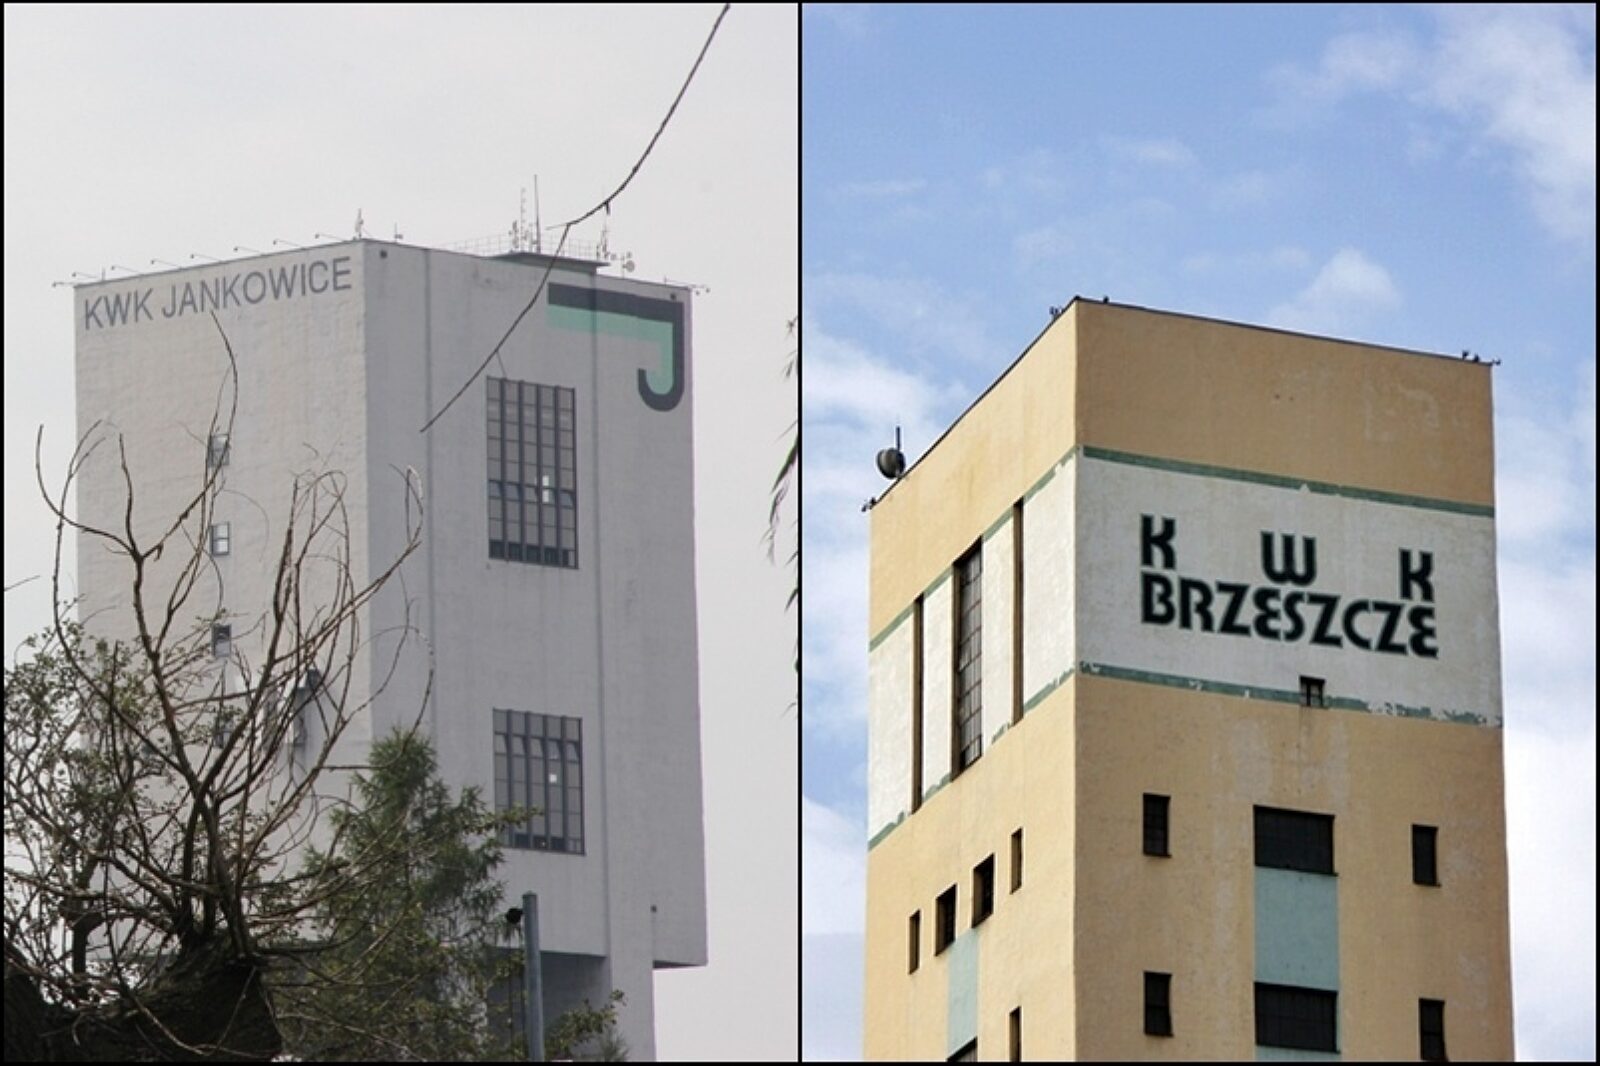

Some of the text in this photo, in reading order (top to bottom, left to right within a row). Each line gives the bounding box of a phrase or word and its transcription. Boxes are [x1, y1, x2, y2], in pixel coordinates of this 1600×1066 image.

[84, 255, 353, 331] KWK JANKOWICE
[1140, 571, 1439, 660] BRZESZCZE
